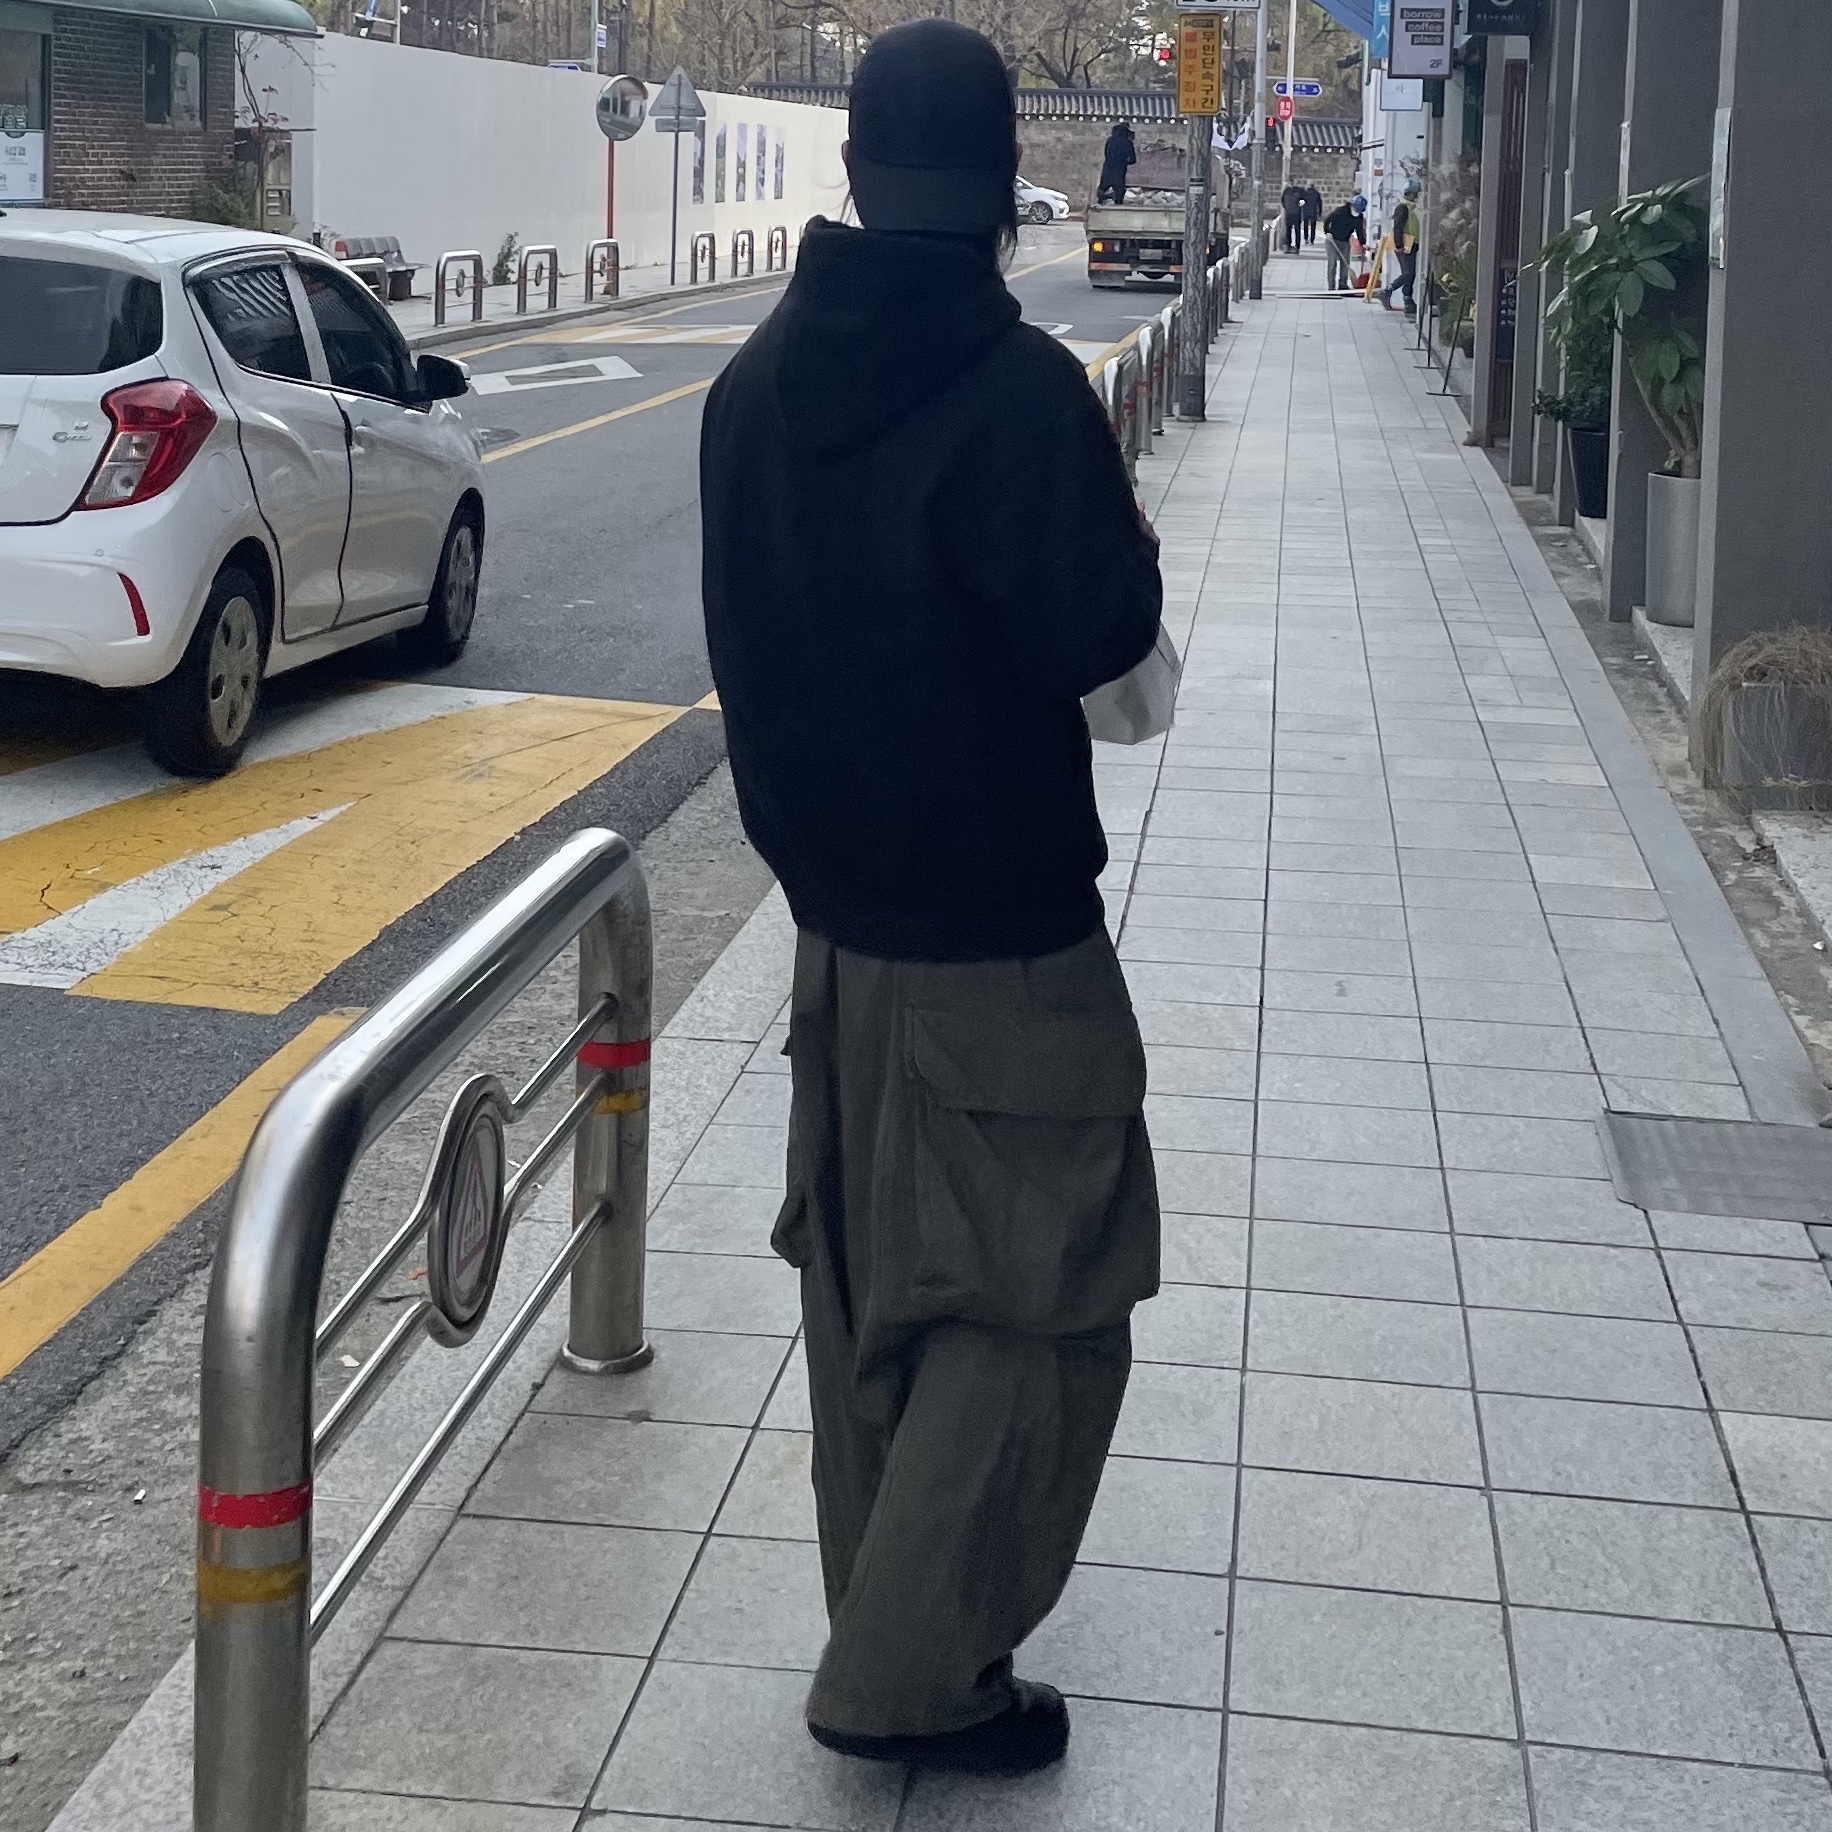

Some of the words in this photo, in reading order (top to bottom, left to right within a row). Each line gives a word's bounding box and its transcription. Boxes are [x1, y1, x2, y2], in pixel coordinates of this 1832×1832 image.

[1403, 9, 1442, 18] borrow
[1407, 22, 1442, 31] coffee
[1413, 35, 1441, 44] place
[1429, 59, 1443, 68] 2F
